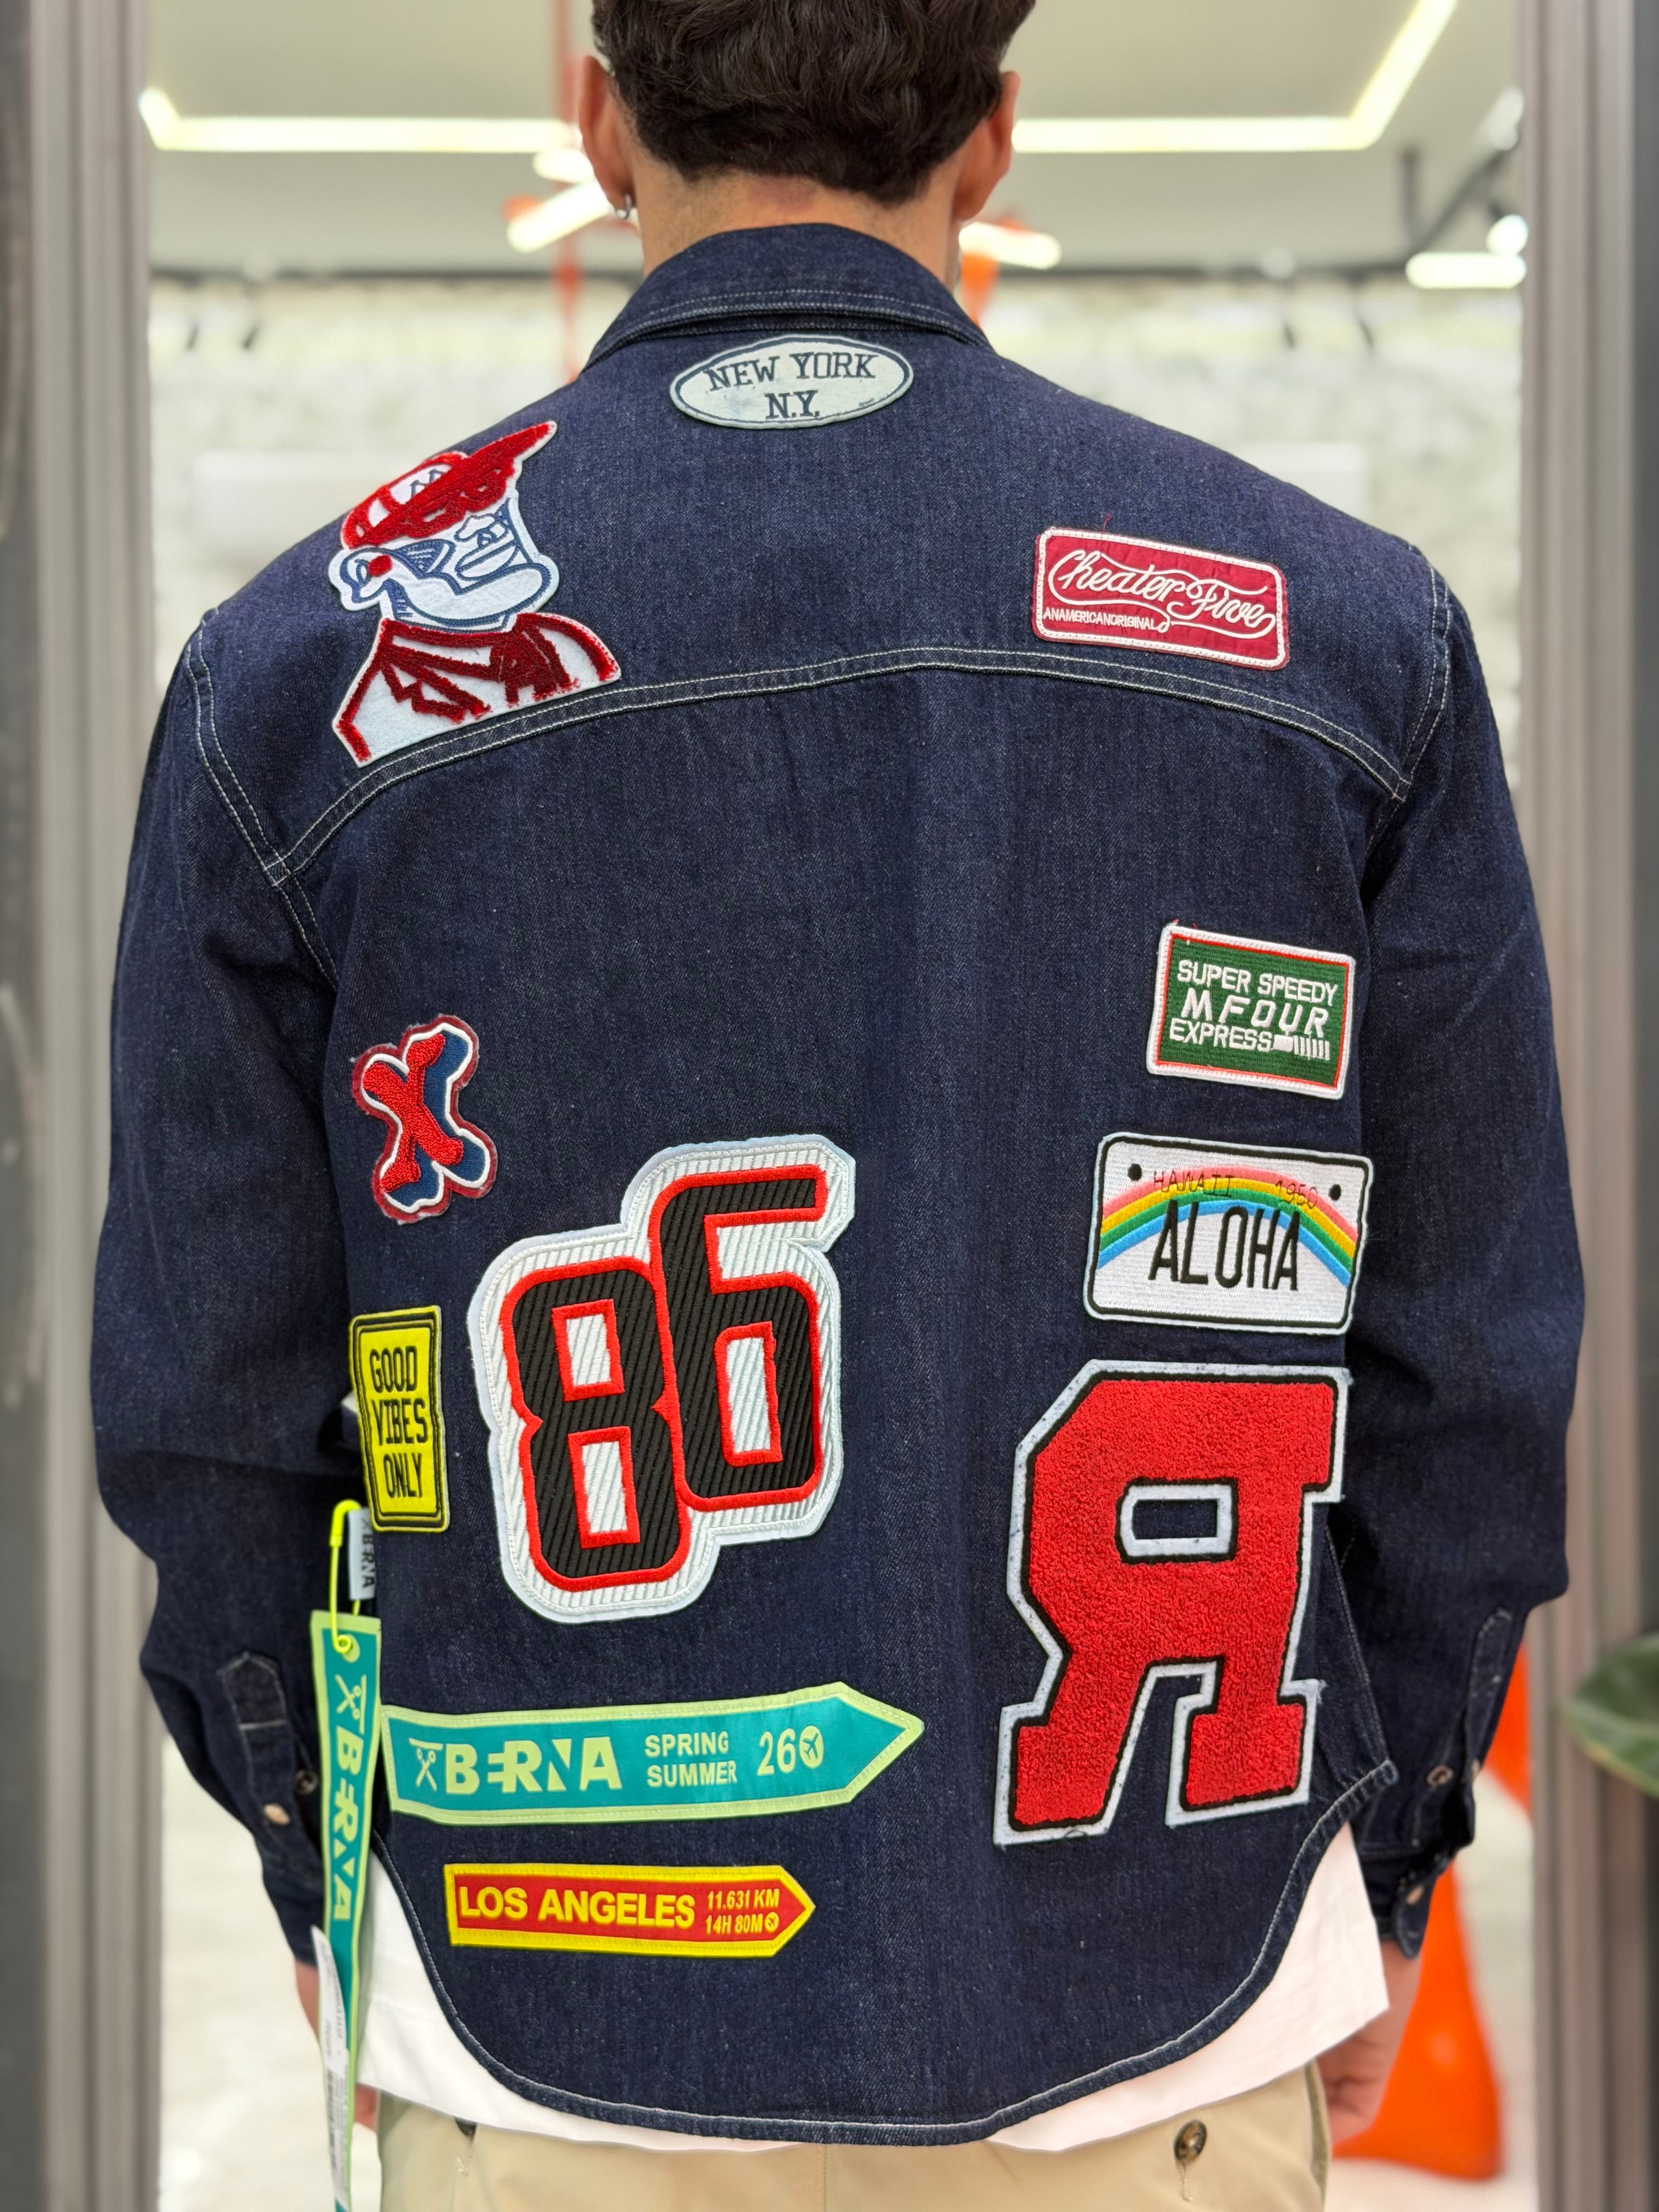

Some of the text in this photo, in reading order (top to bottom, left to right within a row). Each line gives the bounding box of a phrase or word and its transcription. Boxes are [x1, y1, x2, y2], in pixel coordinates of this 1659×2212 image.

[703, 351, 879, 392] NEW YORK
[765, 390, 820, 421] N.Y.
[1048, 549, 1189, 607] Cheater
[1177, 959, 1339, 1007] SUPER SPEEDY
[1169, 1017, 1272, 1052] EXPRESS
[1153, 1170, 1235, 1198] HAWAII
[1148, 1199, 1301, 1291] ALOHA
[369, 1345, 418, 1393] GOOD
[500, 1163, 827, 1593] 86
[371, 1397, 428, 1446] VIBES
[383, 1452, 423, 1498] ONLY
[645, 1731, 729, 1757] SPRING
[646, 1760, 737, 1787] SUMMER
[459, 1886, 695, 1929] LOS ANGELES
[708, 1888, 780, 1911] 11.631 KM
[706, 1912, 763, 1935] 14H 80M
